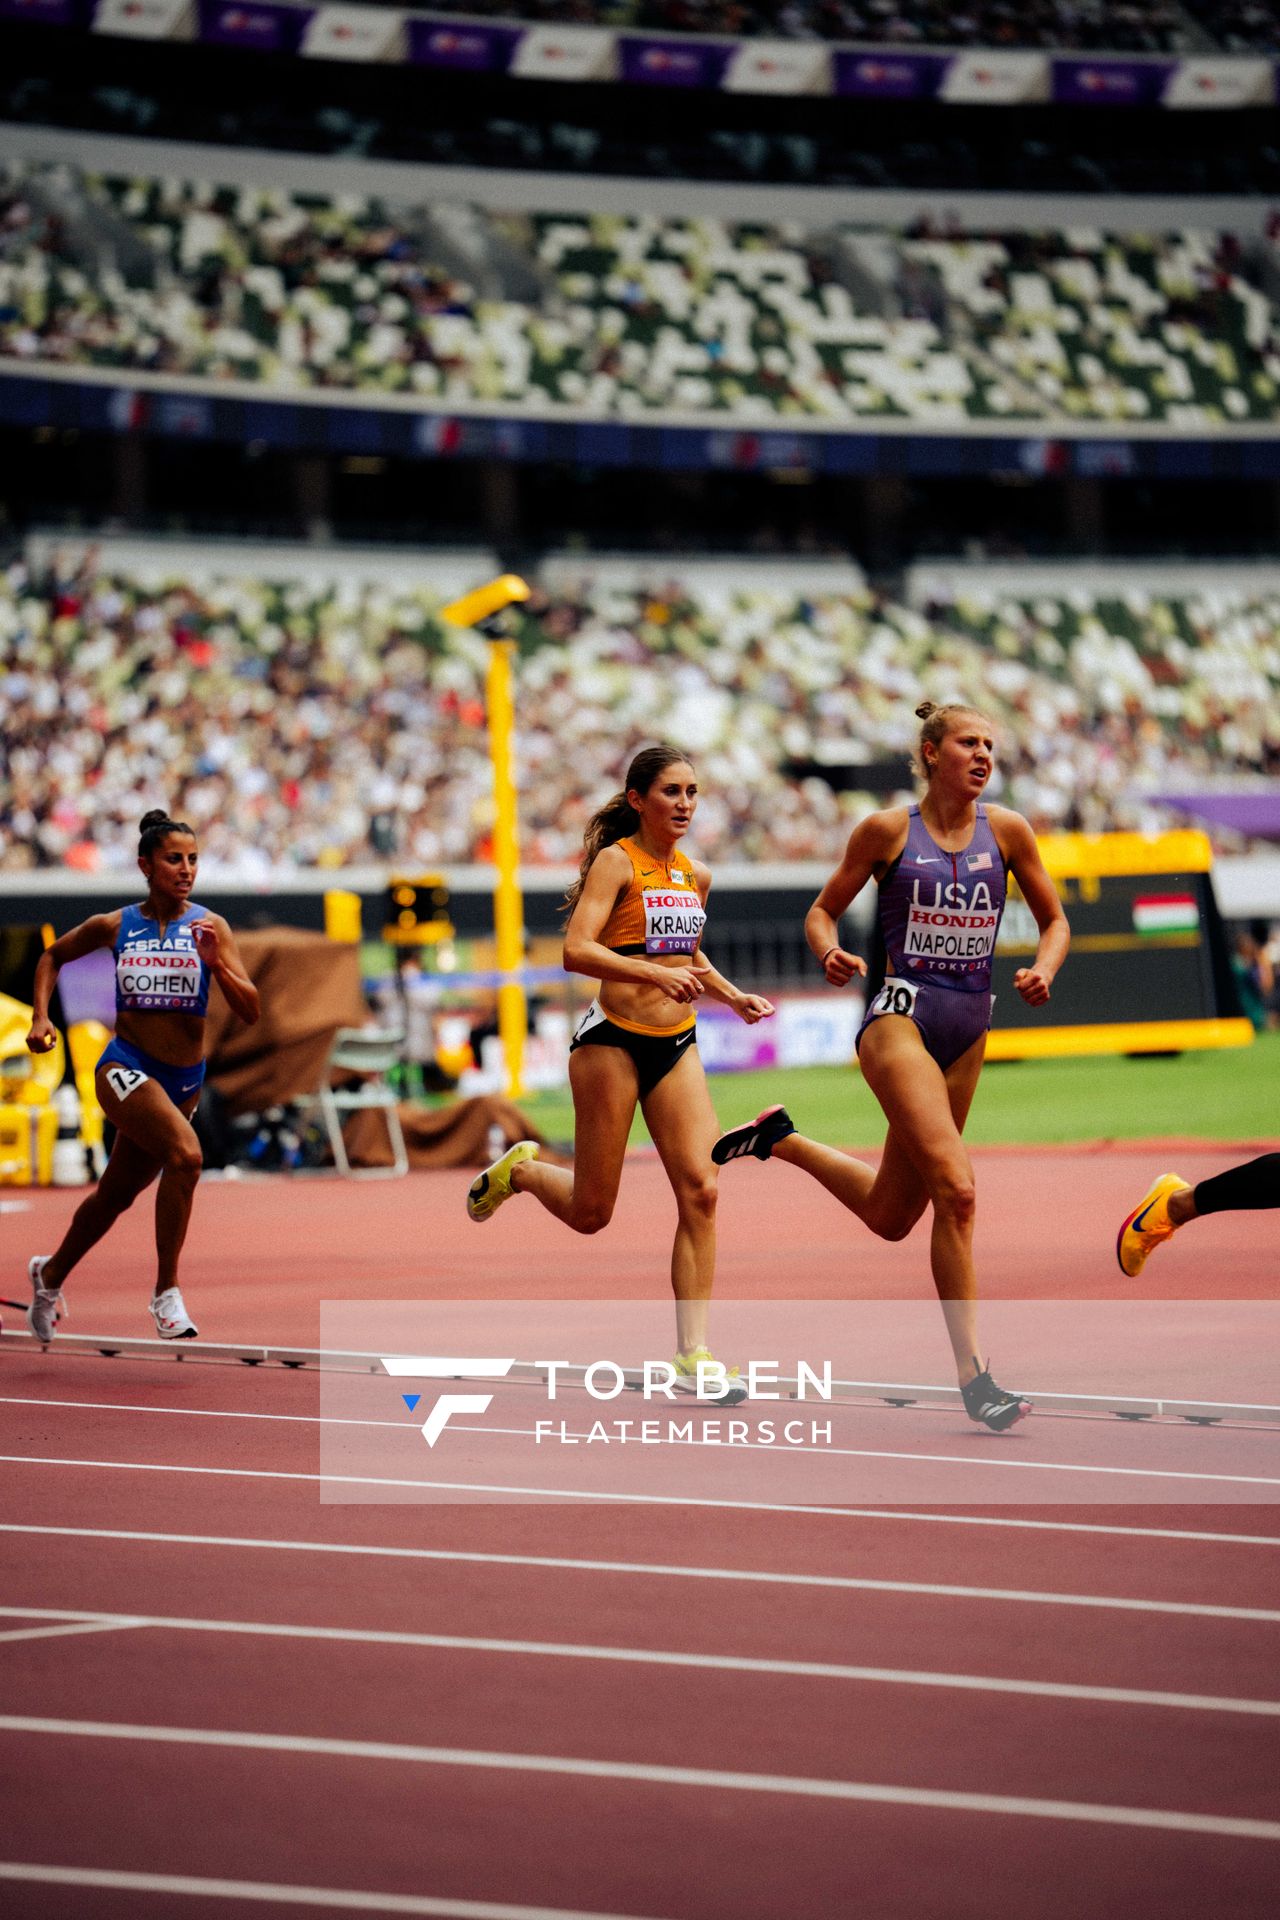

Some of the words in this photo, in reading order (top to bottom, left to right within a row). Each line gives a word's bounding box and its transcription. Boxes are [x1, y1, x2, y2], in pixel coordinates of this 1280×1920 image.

[645, 895, 701, 909] HONDA
[913, 878, 992, 911] USA
[910, 910, 996, 928] HONDA
[123, 939, 196, 953] ISRAEL
[910, 931, 992, 957] NAPOLEON
[120, 957, 198, 968] HONDA
[122, 975, 195, 994] COHEN
[881, 985, 912, 1015] 10
[112, 1069, 140, 1092] 13
